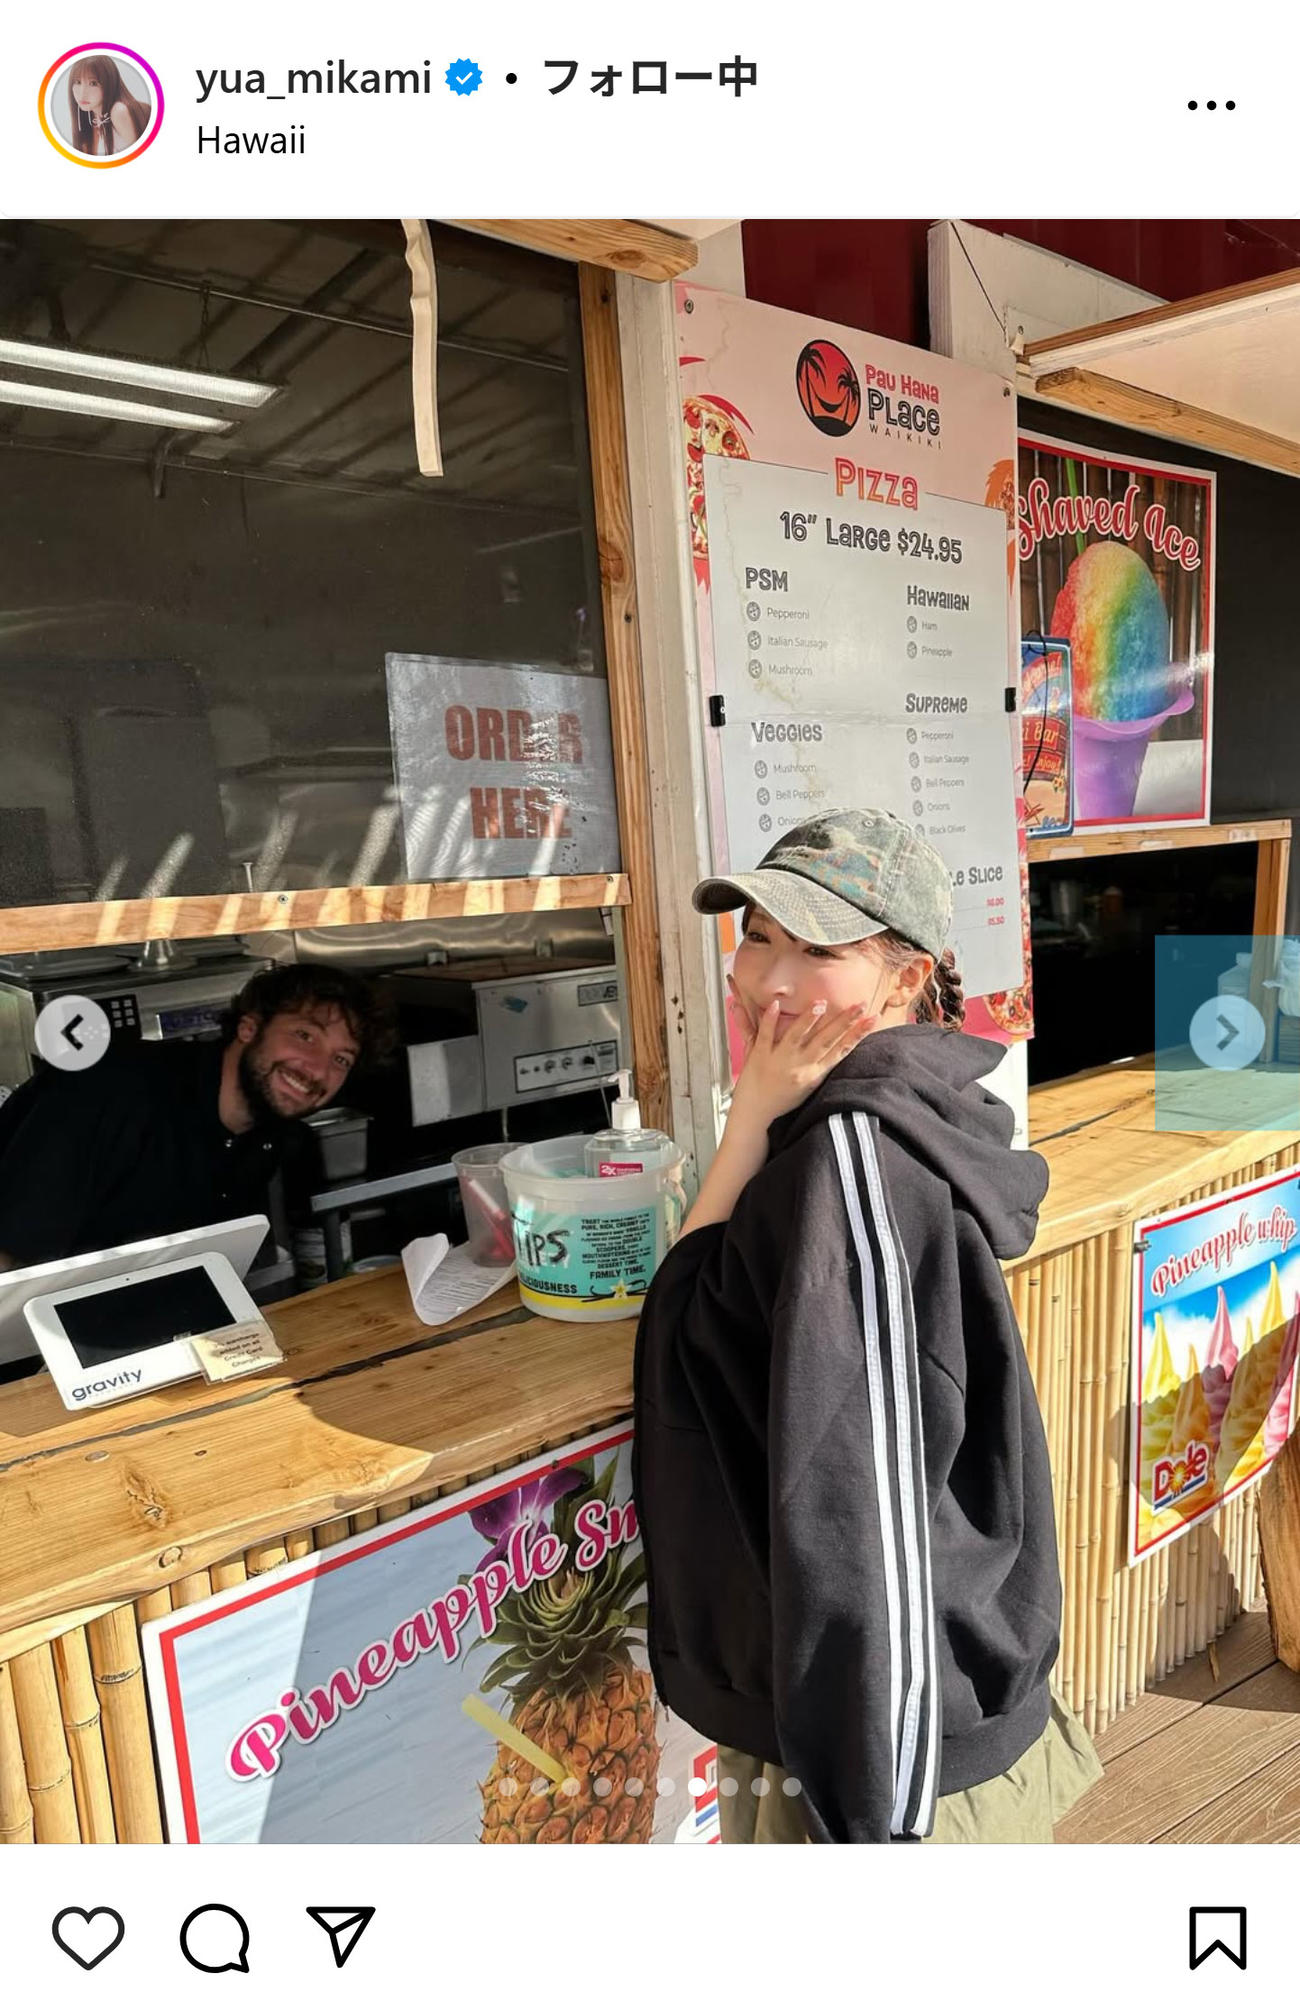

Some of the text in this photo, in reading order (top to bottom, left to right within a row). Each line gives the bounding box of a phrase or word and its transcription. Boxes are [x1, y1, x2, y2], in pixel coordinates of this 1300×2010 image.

[869, 424, 942, 449] WAIKIKI
[898, 528, 963, 565] $24.95
[1144, 504, 1201, 571] Ice
[745, 567, 788, 592] PSM
[767, 607, 810, 621] Pepperoni
[768, 636, 829, 650] Italian Sausage
[768, 665, 813, 677] Mushroom
[773, 762, 817, 775] Mushroom
[776, 790, 791, 801] Bell
[511, 1210, 571, 1267] TIPS
[1151, 1206, 1298, 1297] Pineapple whip
[590, 1269, 621, 1280] FAMILY
[71, 1368, 142, 1402] gravity
[1154, 1442, 1208, 1501] Dole
[226, 1517, 568, 1781] Pineapple
